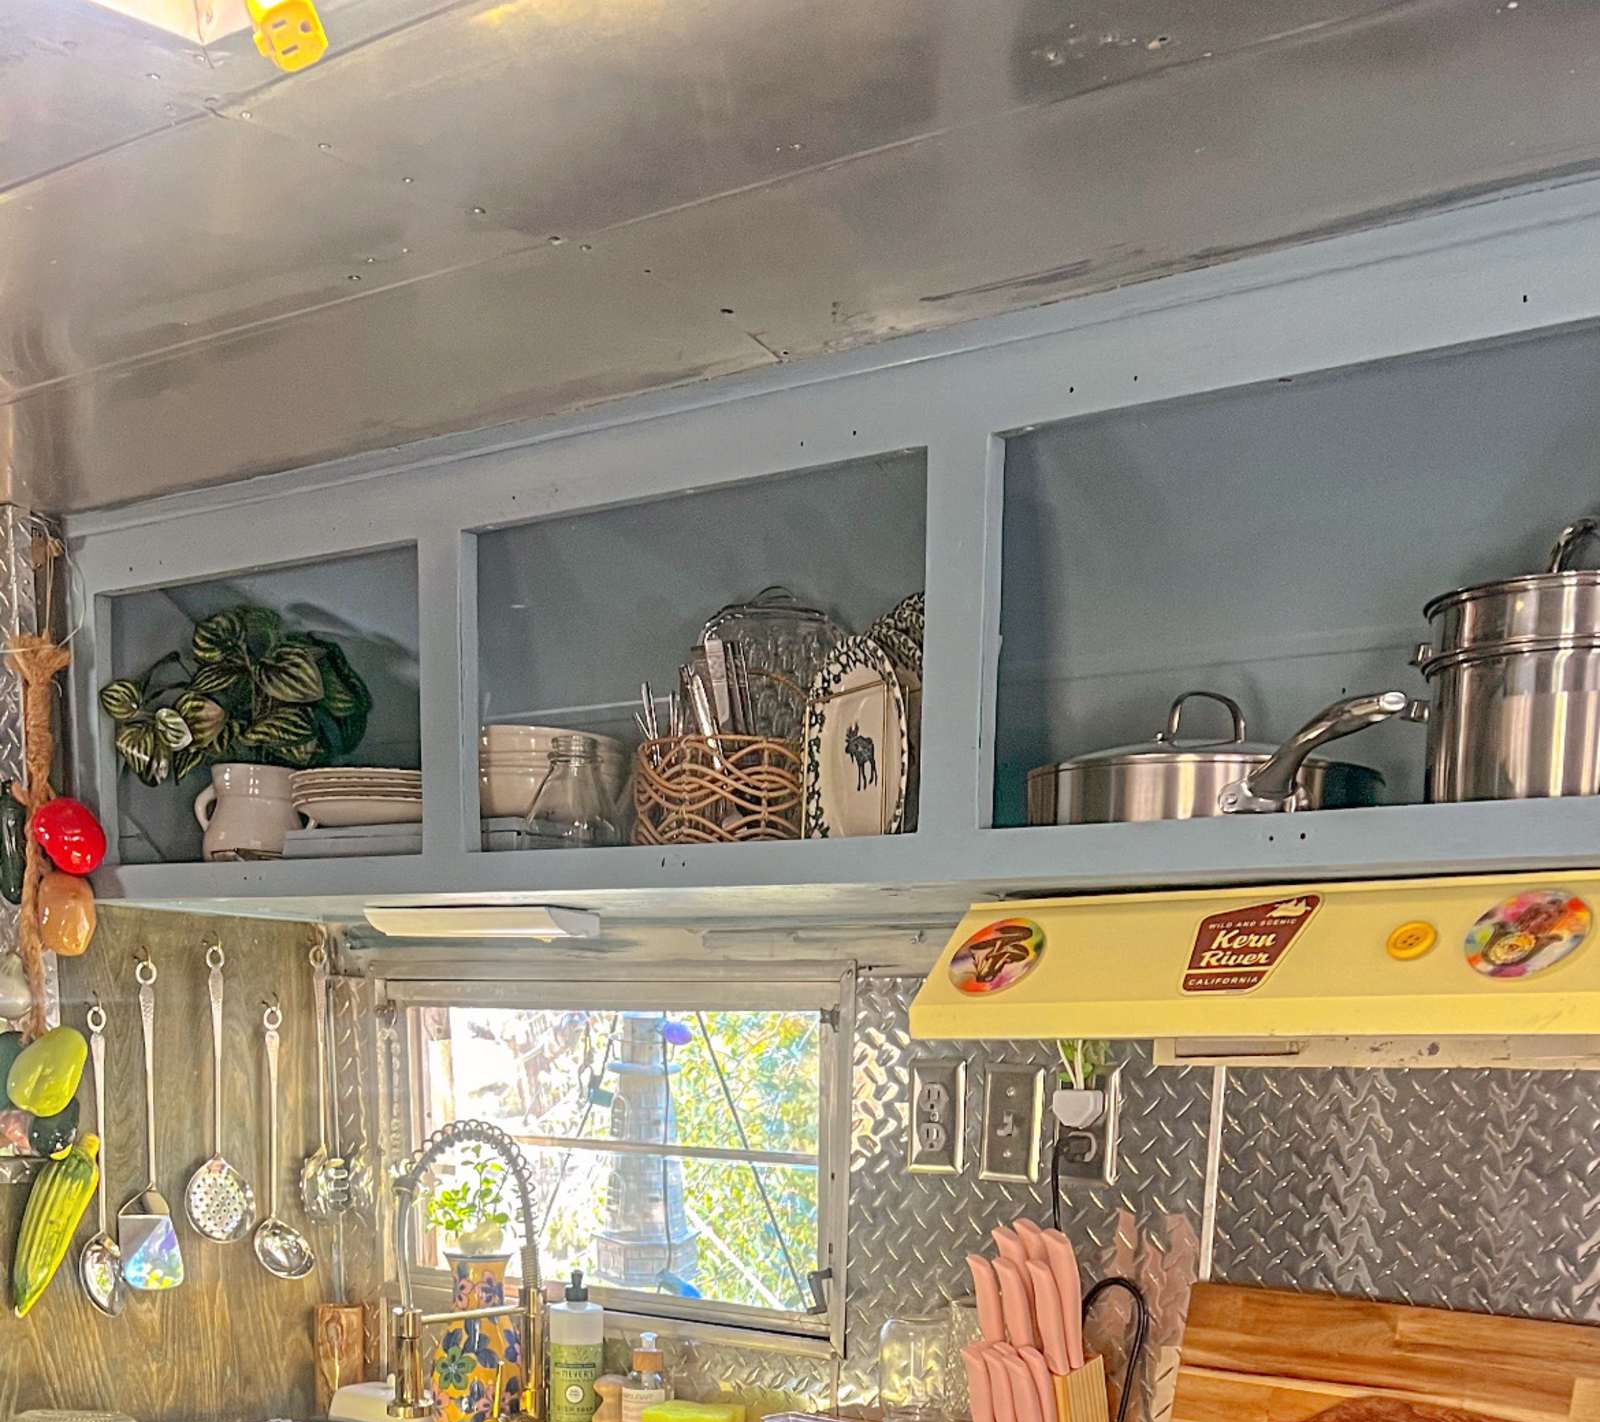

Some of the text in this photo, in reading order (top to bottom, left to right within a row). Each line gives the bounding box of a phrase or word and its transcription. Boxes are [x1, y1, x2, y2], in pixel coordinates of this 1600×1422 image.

[1209, 918, 1298, 930] WILD AND SCENIC
[1211, 929, 1277, 950] Kern
[1201, 950, 1270, 967] River
[1188, 976, 1258, 986] CALIFORNIA
